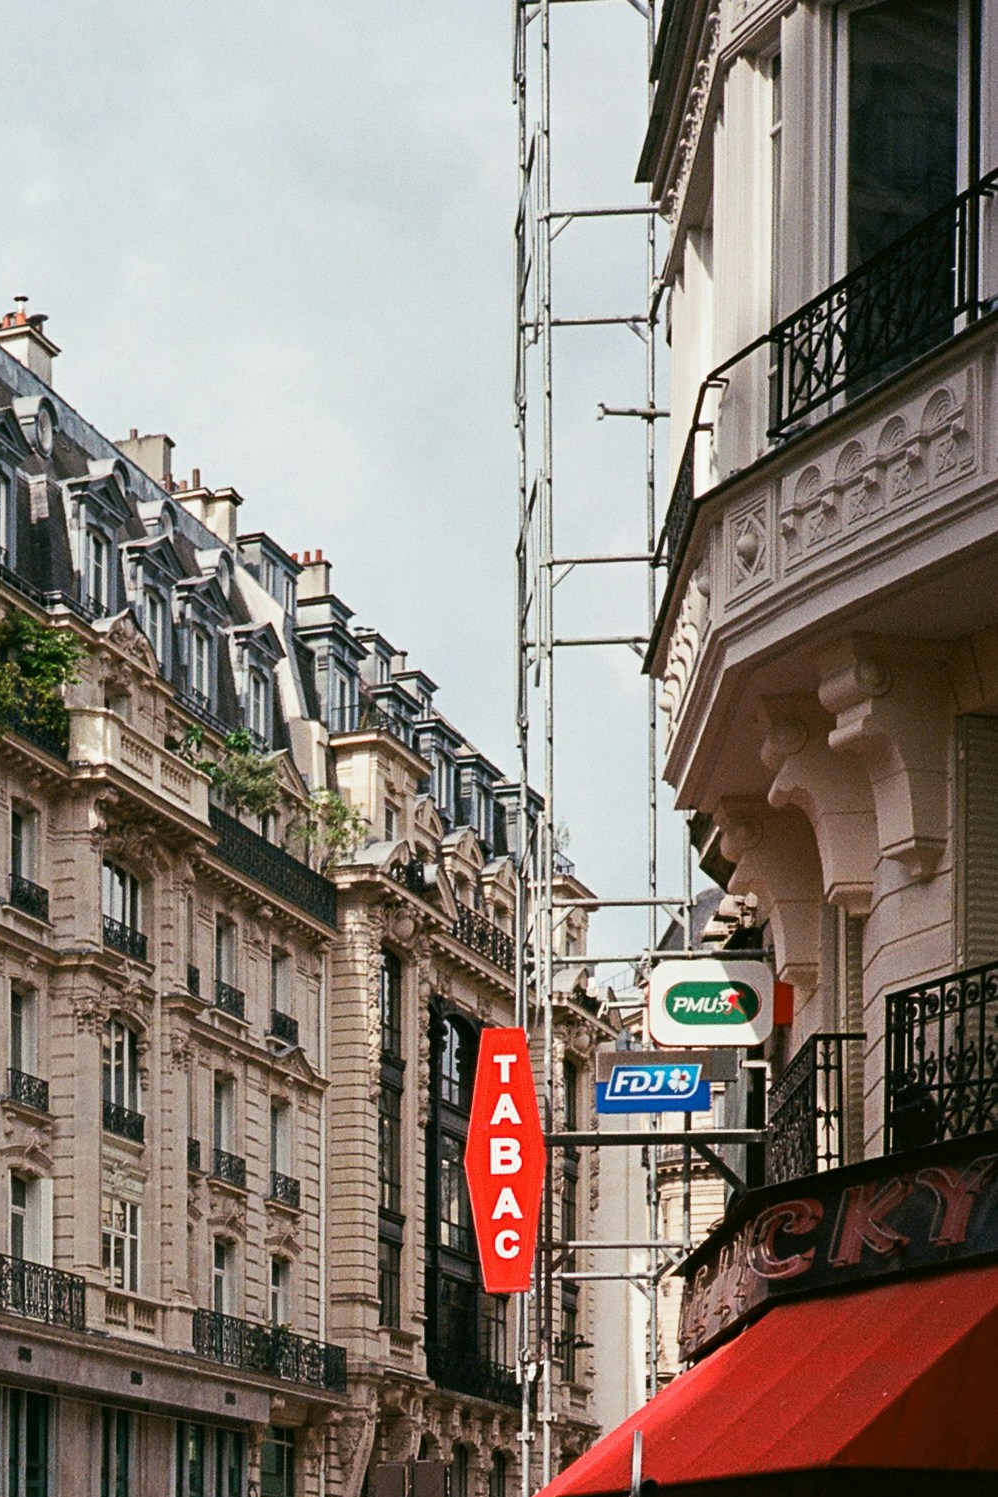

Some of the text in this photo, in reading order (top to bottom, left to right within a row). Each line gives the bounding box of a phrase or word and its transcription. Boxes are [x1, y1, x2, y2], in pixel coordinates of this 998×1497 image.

[672, 996, 719, 1014] PMU
[613, 1069, 666, 1094] FDJ
[488, 1053, 524, 1260] TABAC
